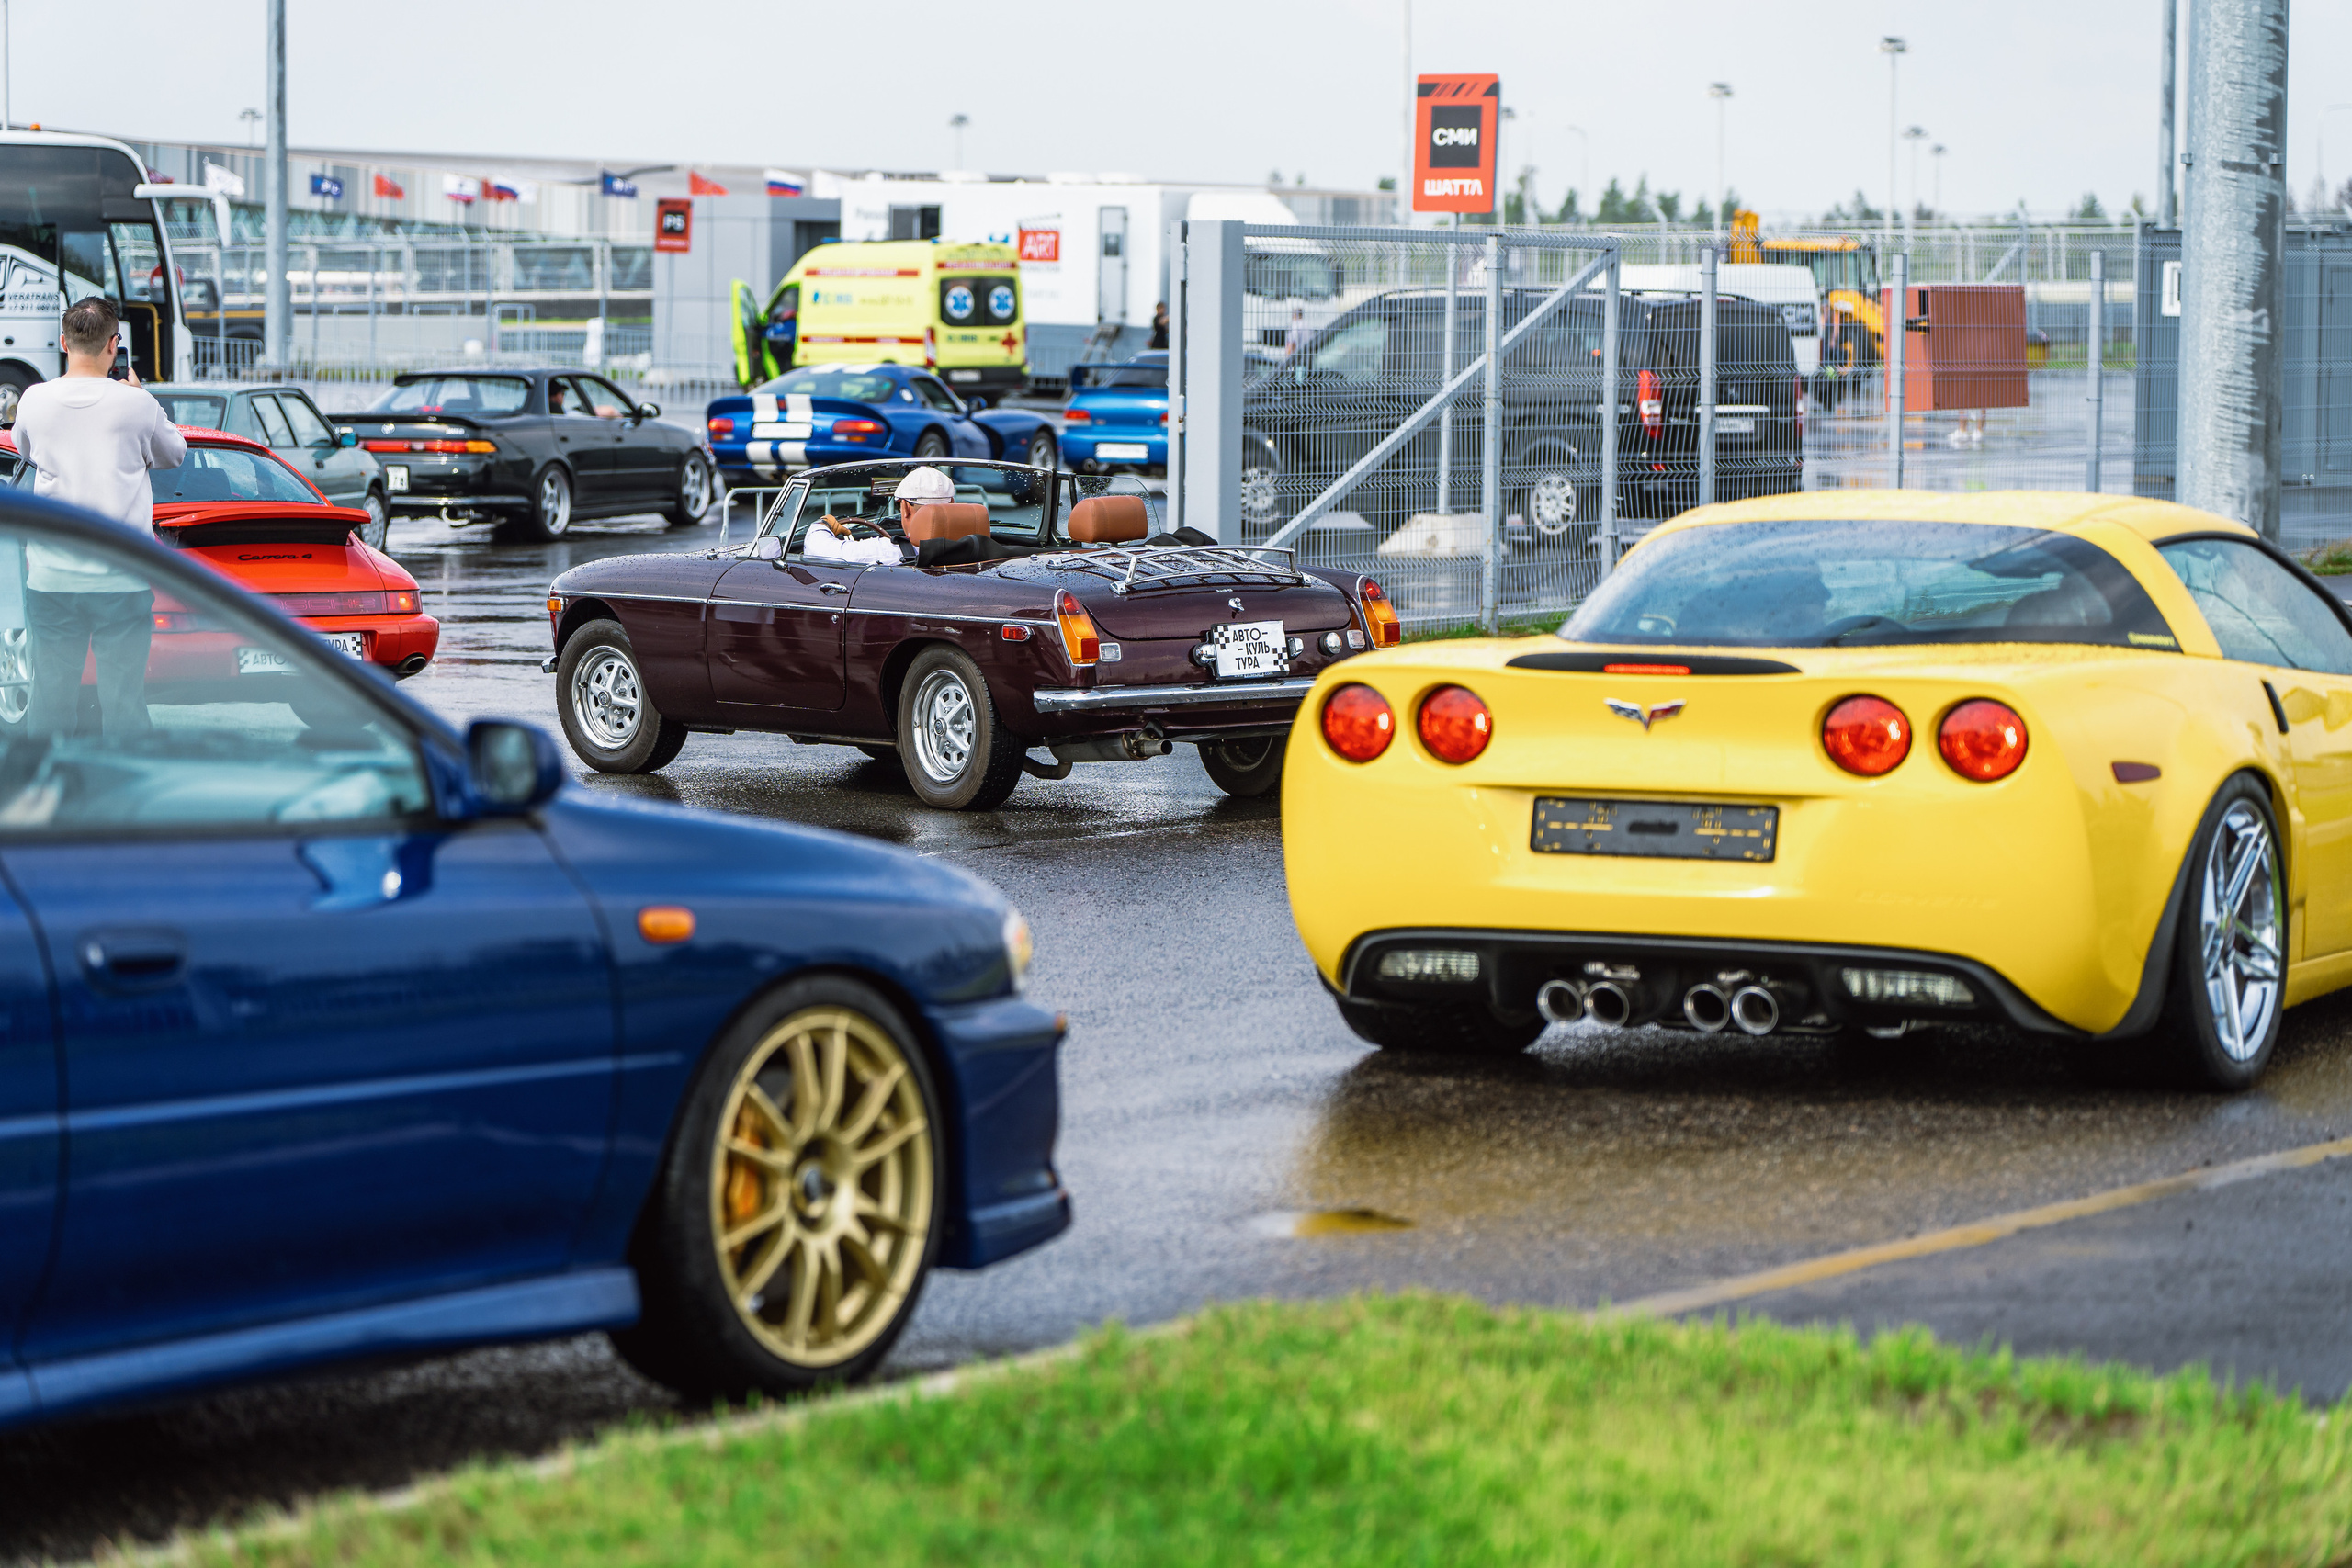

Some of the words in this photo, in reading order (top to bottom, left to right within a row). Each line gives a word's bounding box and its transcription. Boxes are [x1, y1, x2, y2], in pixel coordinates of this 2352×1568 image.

[1433, 127, 1477, 146] СМИ
[1423, 179, 1483, 196] ШАТТЛ
[1021, 232, 1057, 258] ART
[1235, 656, 1260, 670] ТУРА
